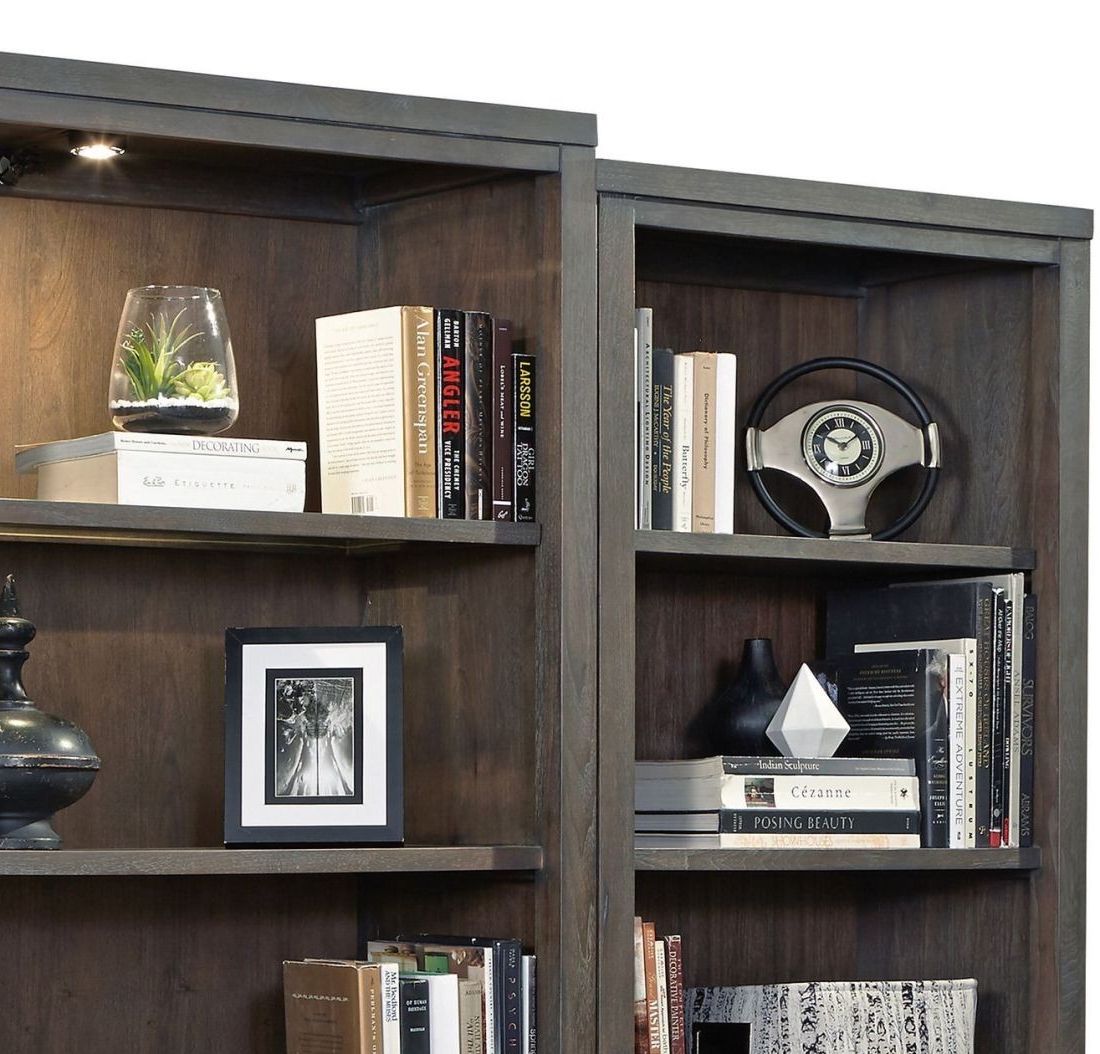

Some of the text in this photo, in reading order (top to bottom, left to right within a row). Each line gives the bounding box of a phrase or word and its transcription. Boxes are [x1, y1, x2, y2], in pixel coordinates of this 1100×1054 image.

[414, 315, 429, 454] Alan Greenspan
[443, 356, 460, 434] ANGLER
[520, 362, 530, 417] LARSSON
[663, 385, 672, 404] The
[663, 406, 672, 429] Year
[193, 440, 260, 453] DECORATING
[662, 432, 671, 443] of
[662, 462, 671, 493] People
[680, 446, 689, 489] Butterfly
[956, 677, 964, 738] EXTREME
[759, 762, 819, 772] Indian Sculpture
[1021, 679, 1034, 836] SURVIVORS ABRAMS
[792, 786, 852, 798] Cézanne
[754, 816, 854, 829] POSING BEAUTY
[669, 951, 680, 1041] DECORATIVE PAINTER
[649, 1000, 659, 1048] MASTER
